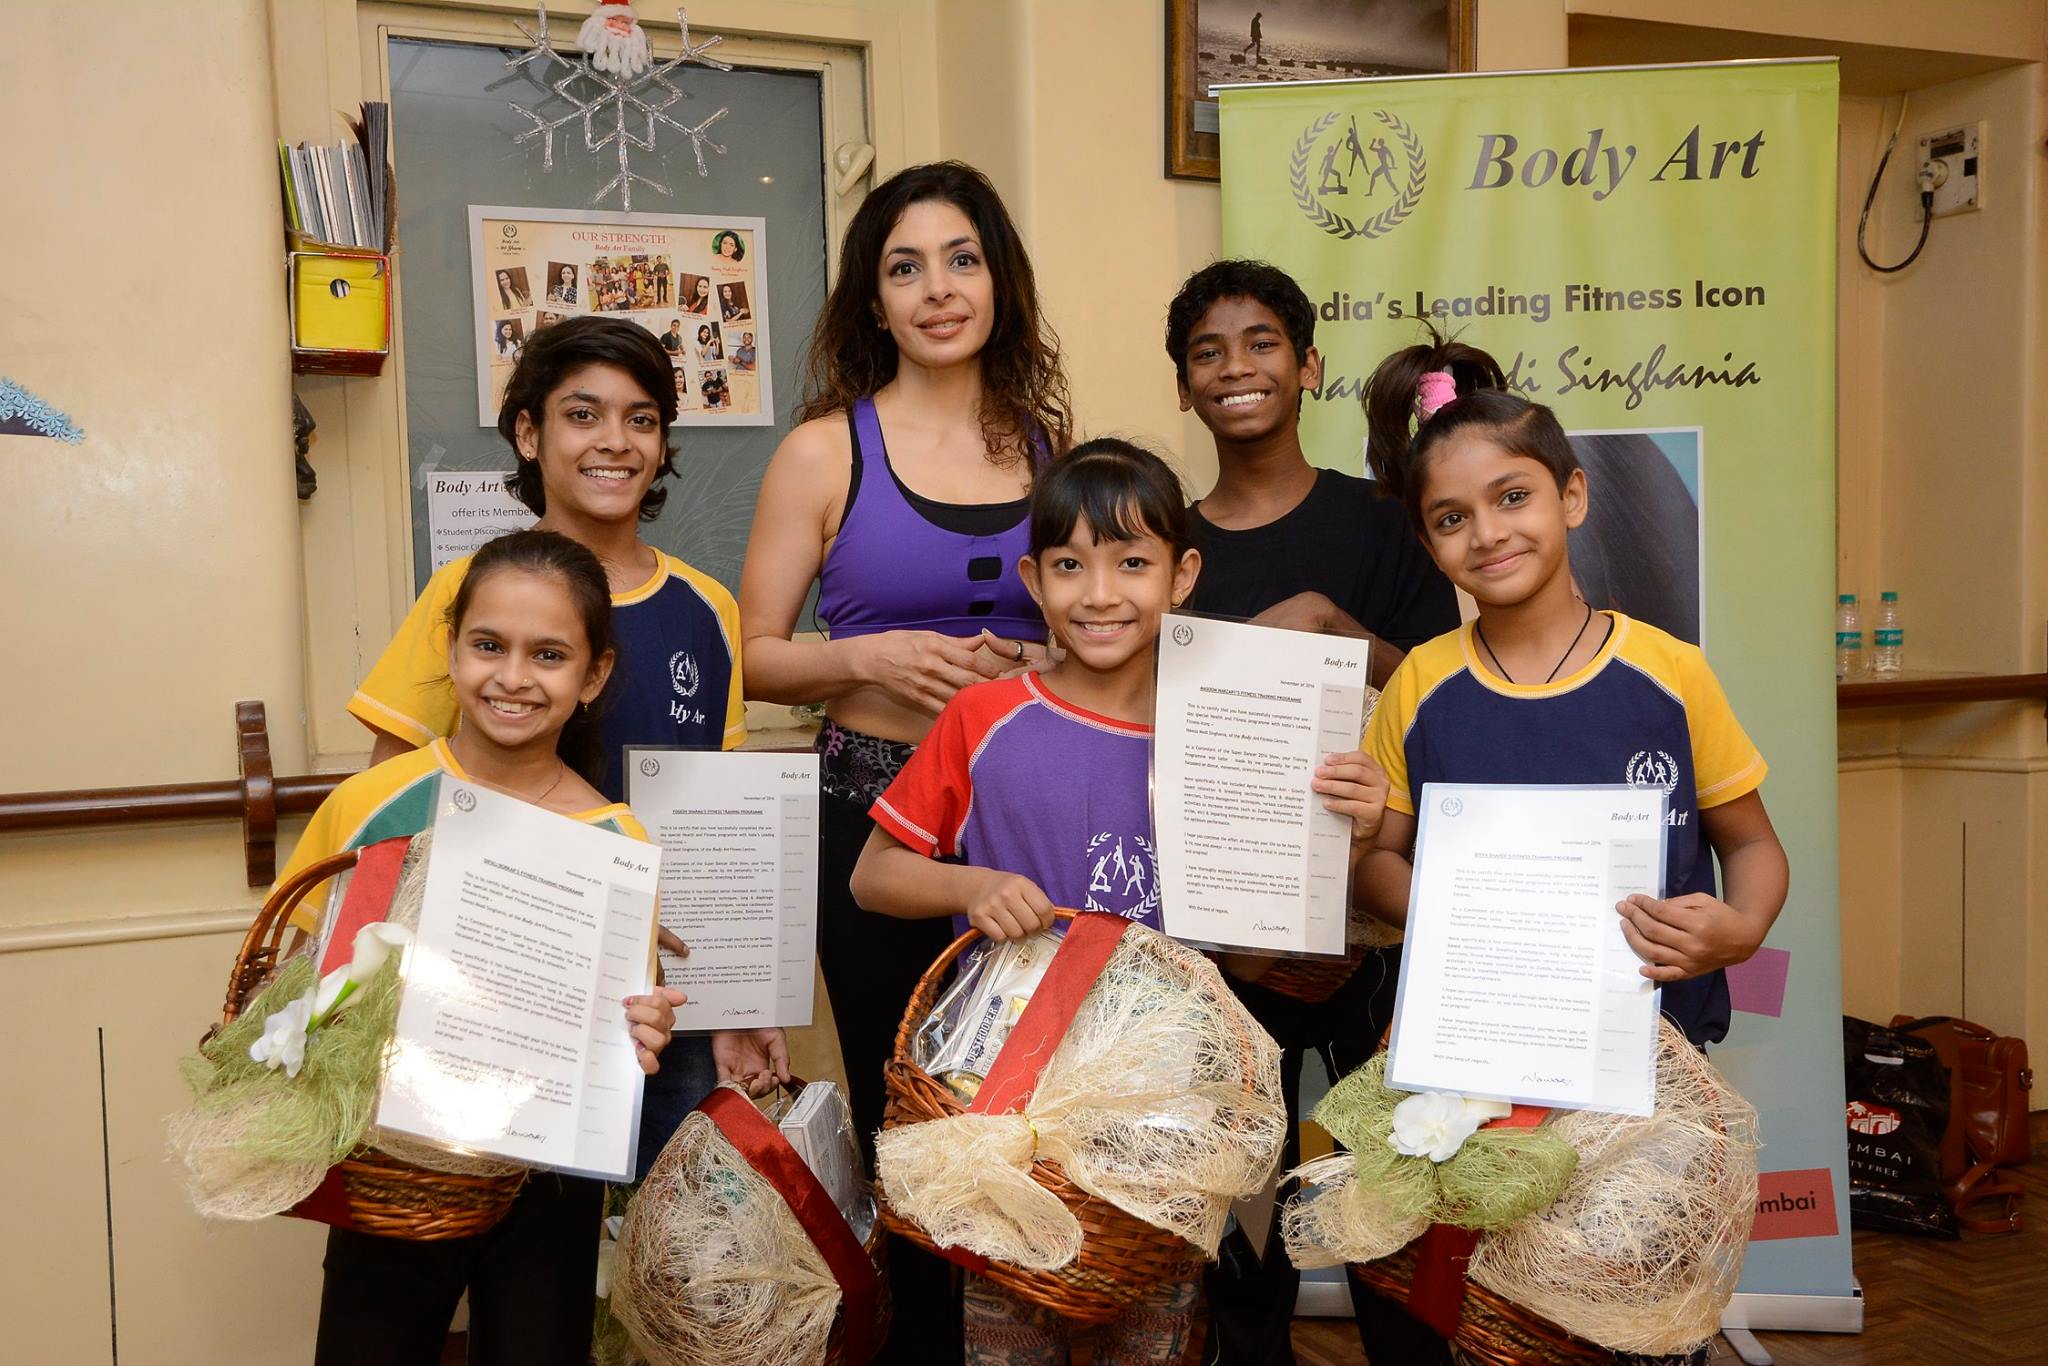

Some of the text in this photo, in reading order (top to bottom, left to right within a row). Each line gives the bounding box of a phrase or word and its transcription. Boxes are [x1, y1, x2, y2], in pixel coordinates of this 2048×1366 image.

[1464, 124, 1766, 201] Body Art
[572, 232, 666, 244] OUR STRENGTH
[1417, 286, 1550, 323] Leading
[1565, 283, 1682, 313] Fitness
[1695, 280, 1766, 308] Icon
[1505, 344, 1760, 410] di Singhania
[436, 480, 471, 496] Body
[475, 480, 499, 492] Art
[452, 508, 476, 517] offer
[479, 508, 490, 517] its
[1324, 657, 1358, 669] Body Art
[780, 772, 798, 780] Body
[1610, 812, 1649, 822] Body Art
[1662, 808, 1689, 826] Art
[613, 856, 649, 872] Body Art
[968, 1007, 998, 1063] DESTROOPER
[1848, 1143, 1911, 1165] MBAI
[1868, 1164, 1899, 1178] FREE
[1756, 1191, 1816, 1214] mbai
